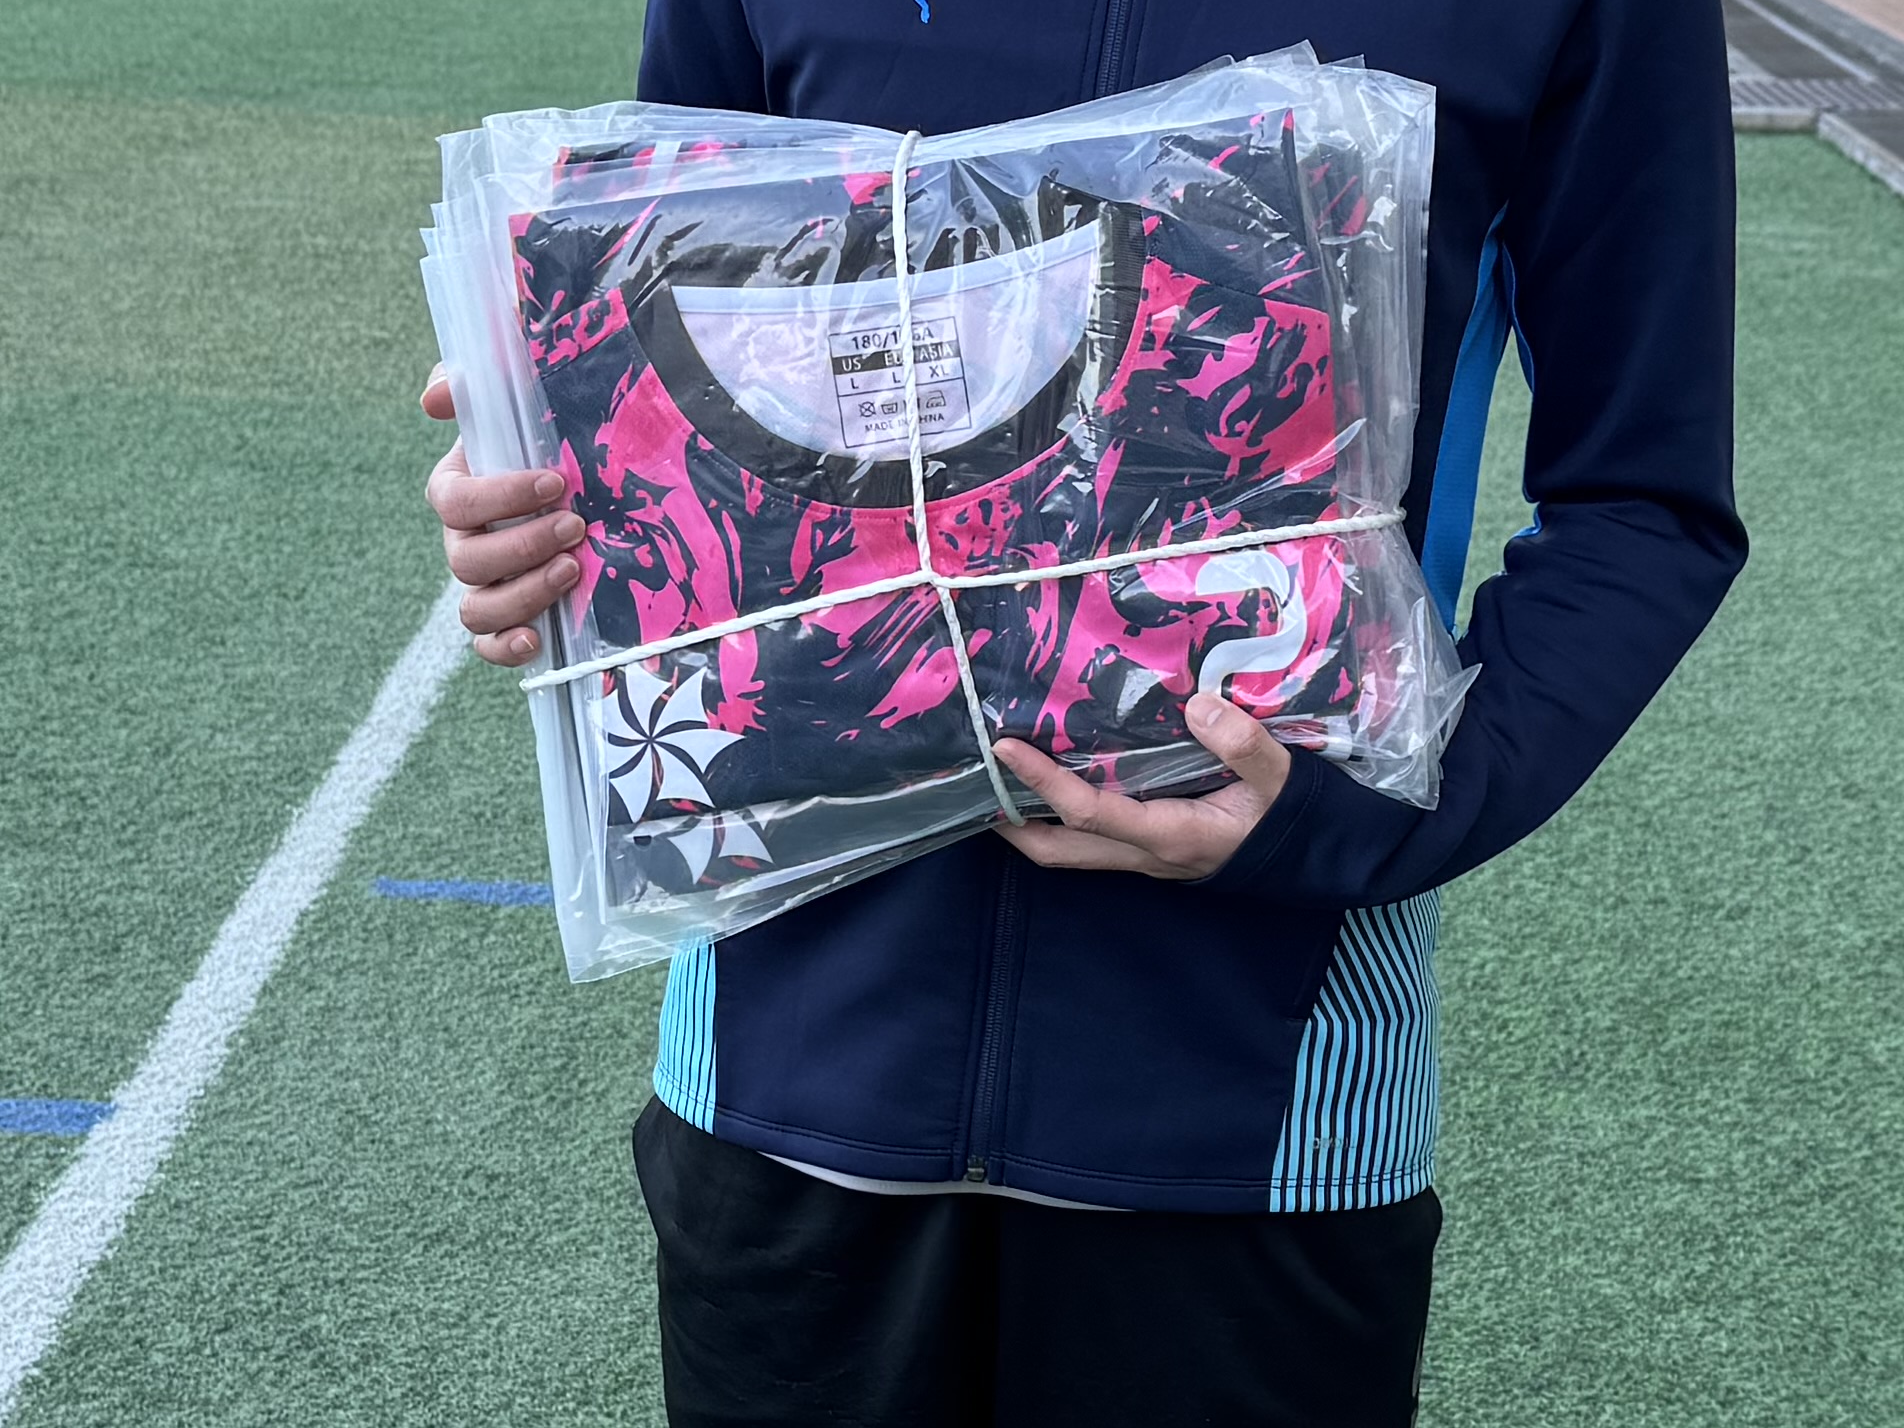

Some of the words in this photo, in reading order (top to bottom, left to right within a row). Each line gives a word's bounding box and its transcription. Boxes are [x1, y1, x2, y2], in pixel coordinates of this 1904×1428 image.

[842, 358, 861, 371] US
[919, 345, 953, 361] ASIA
[850, 377, 859, 390] L
[892, 371, 901, 384] L
[929, 365, 949, 378] XL
[865, 419, 894, 432] MADE
[918, 413, 945, 424] HINA
